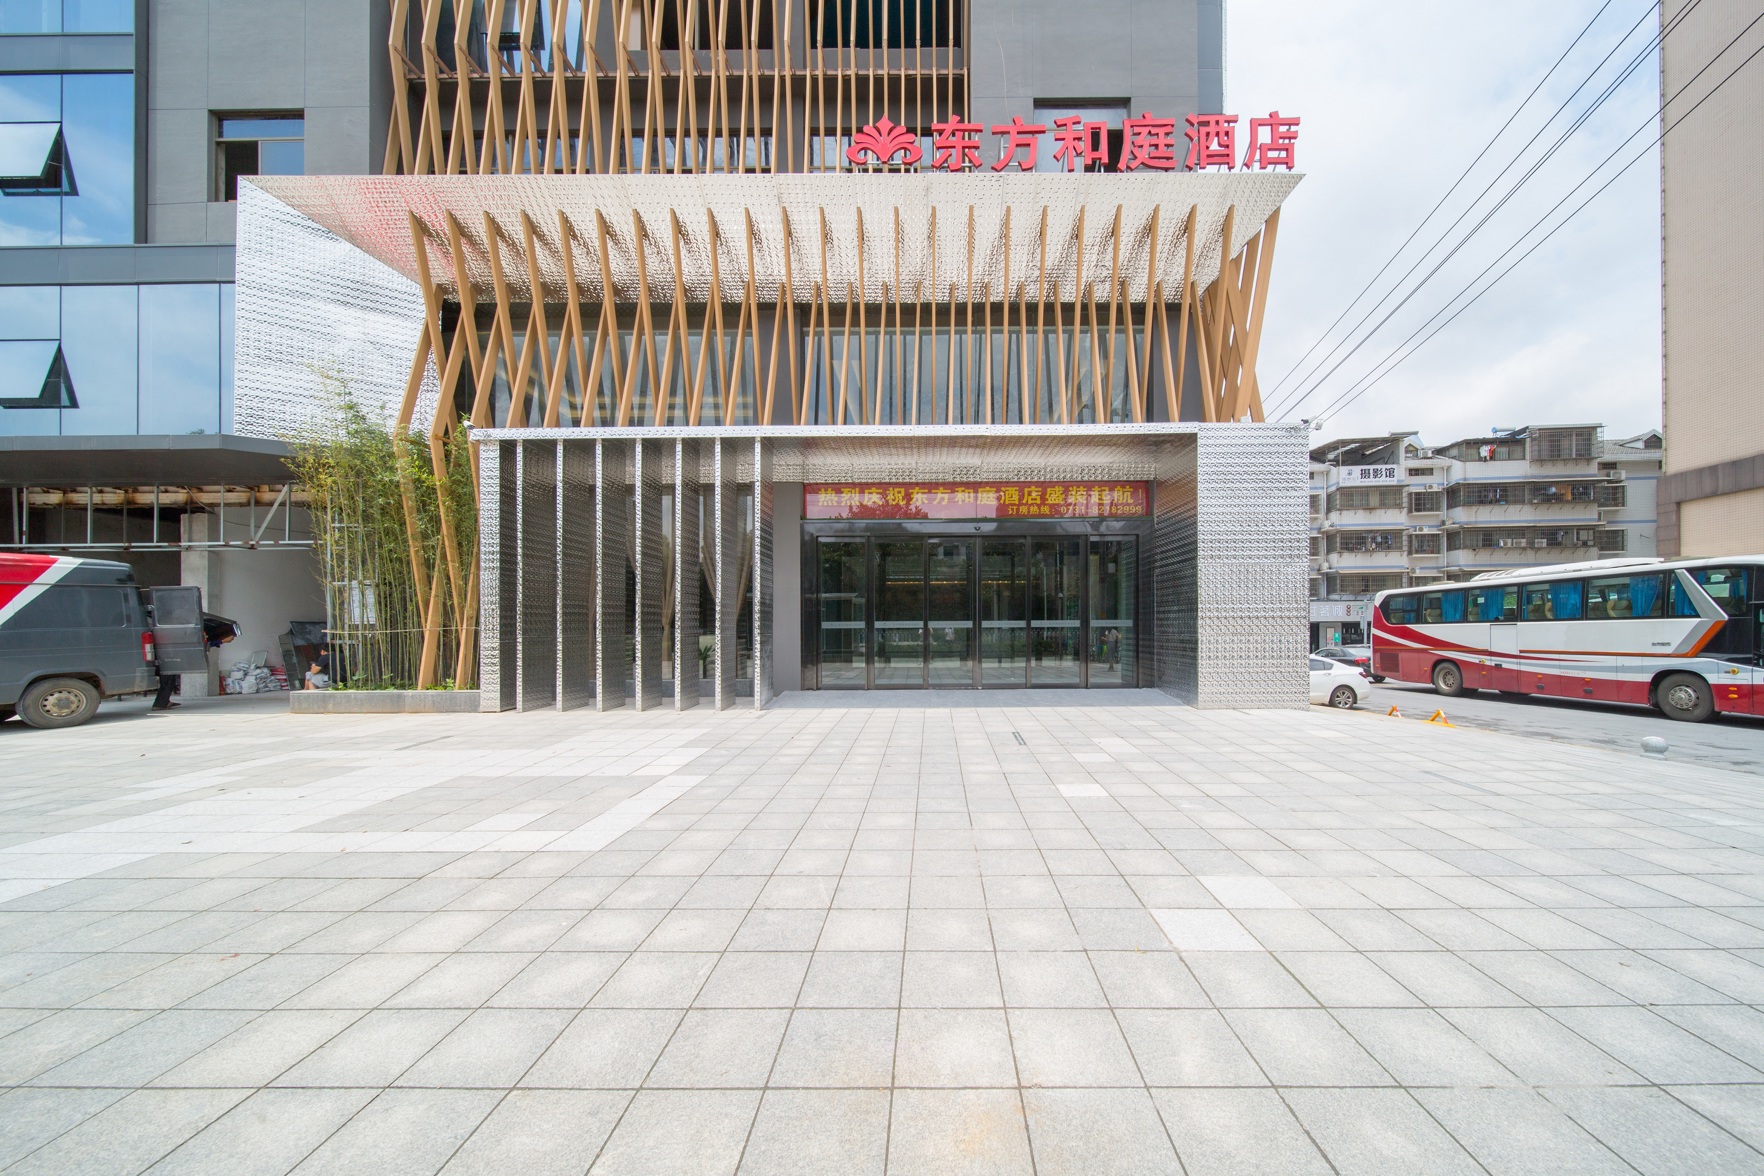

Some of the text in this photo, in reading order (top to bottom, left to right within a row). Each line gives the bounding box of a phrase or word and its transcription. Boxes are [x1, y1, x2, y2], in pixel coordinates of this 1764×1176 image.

[931, 111, 1301, 173] 东方和庭酒店
[1360, 467, 1396, 479] 摄影馆
